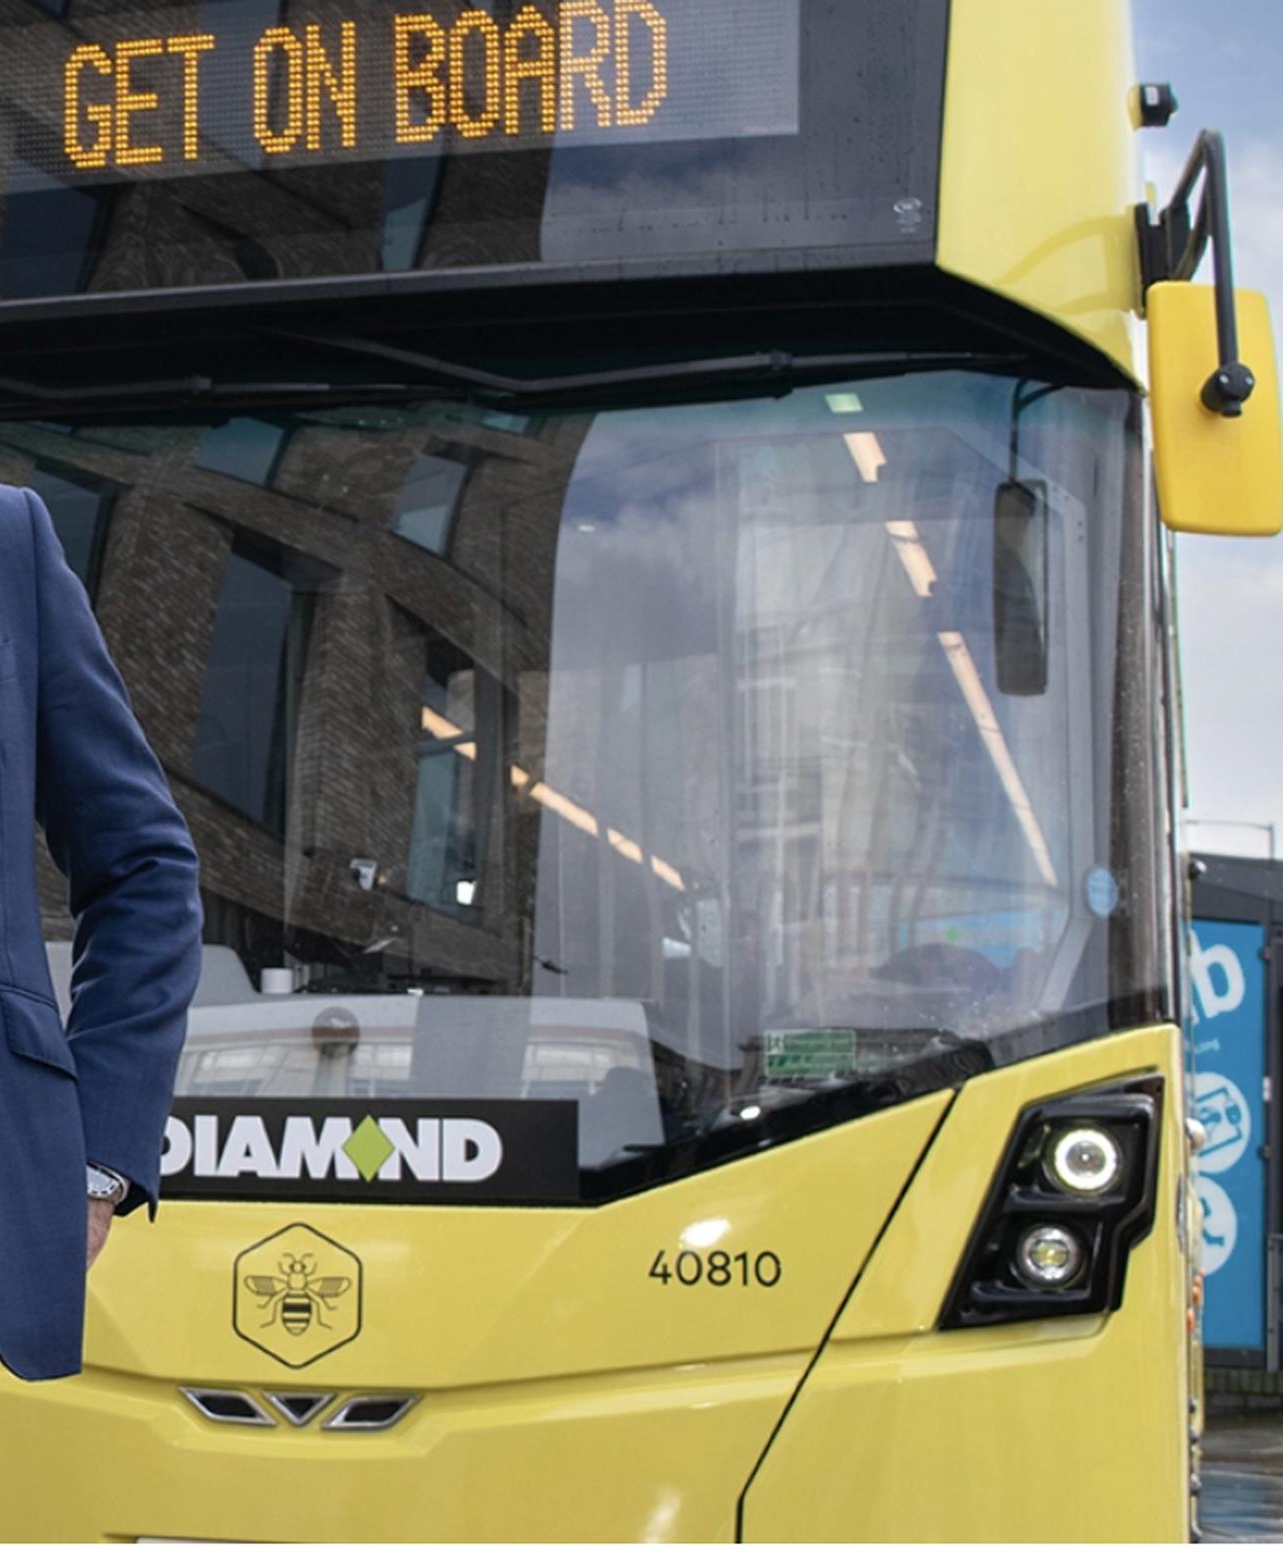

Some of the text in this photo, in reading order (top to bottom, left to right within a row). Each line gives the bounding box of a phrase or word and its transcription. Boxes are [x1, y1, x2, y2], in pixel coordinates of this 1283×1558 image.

[64, 0, 668, 169] GET ON BOARD
[648, 1249, 782, 1287] 40810
